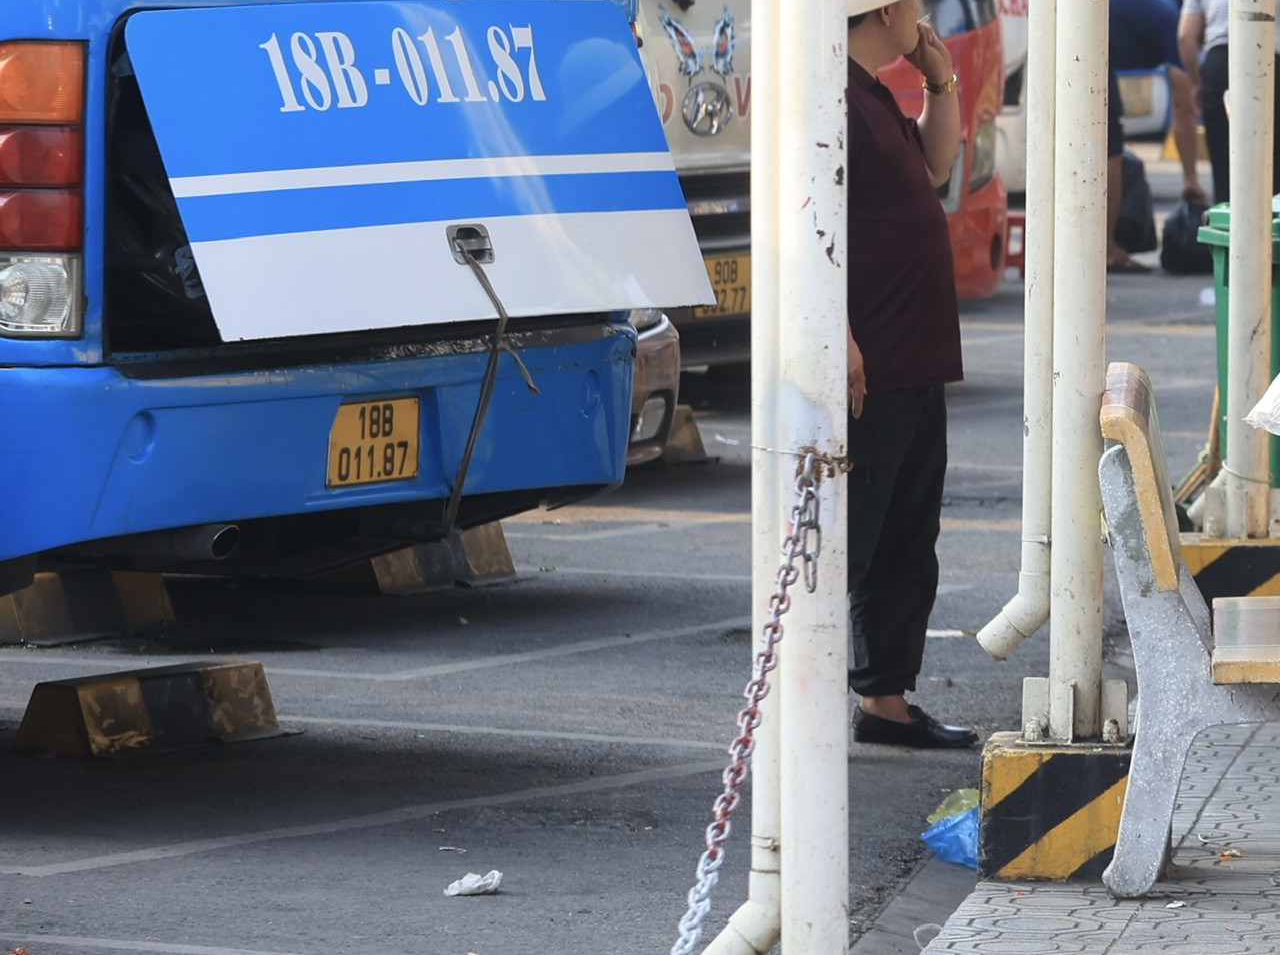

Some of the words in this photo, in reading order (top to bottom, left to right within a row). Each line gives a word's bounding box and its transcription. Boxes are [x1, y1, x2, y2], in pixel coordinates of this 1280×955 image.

[259, 23, 547, 113] 18B-011.87
[714, 260, 738, 284] 90B
[359, 404, 394, 439] 18B
[338, 441, 408, 481] 011.87
